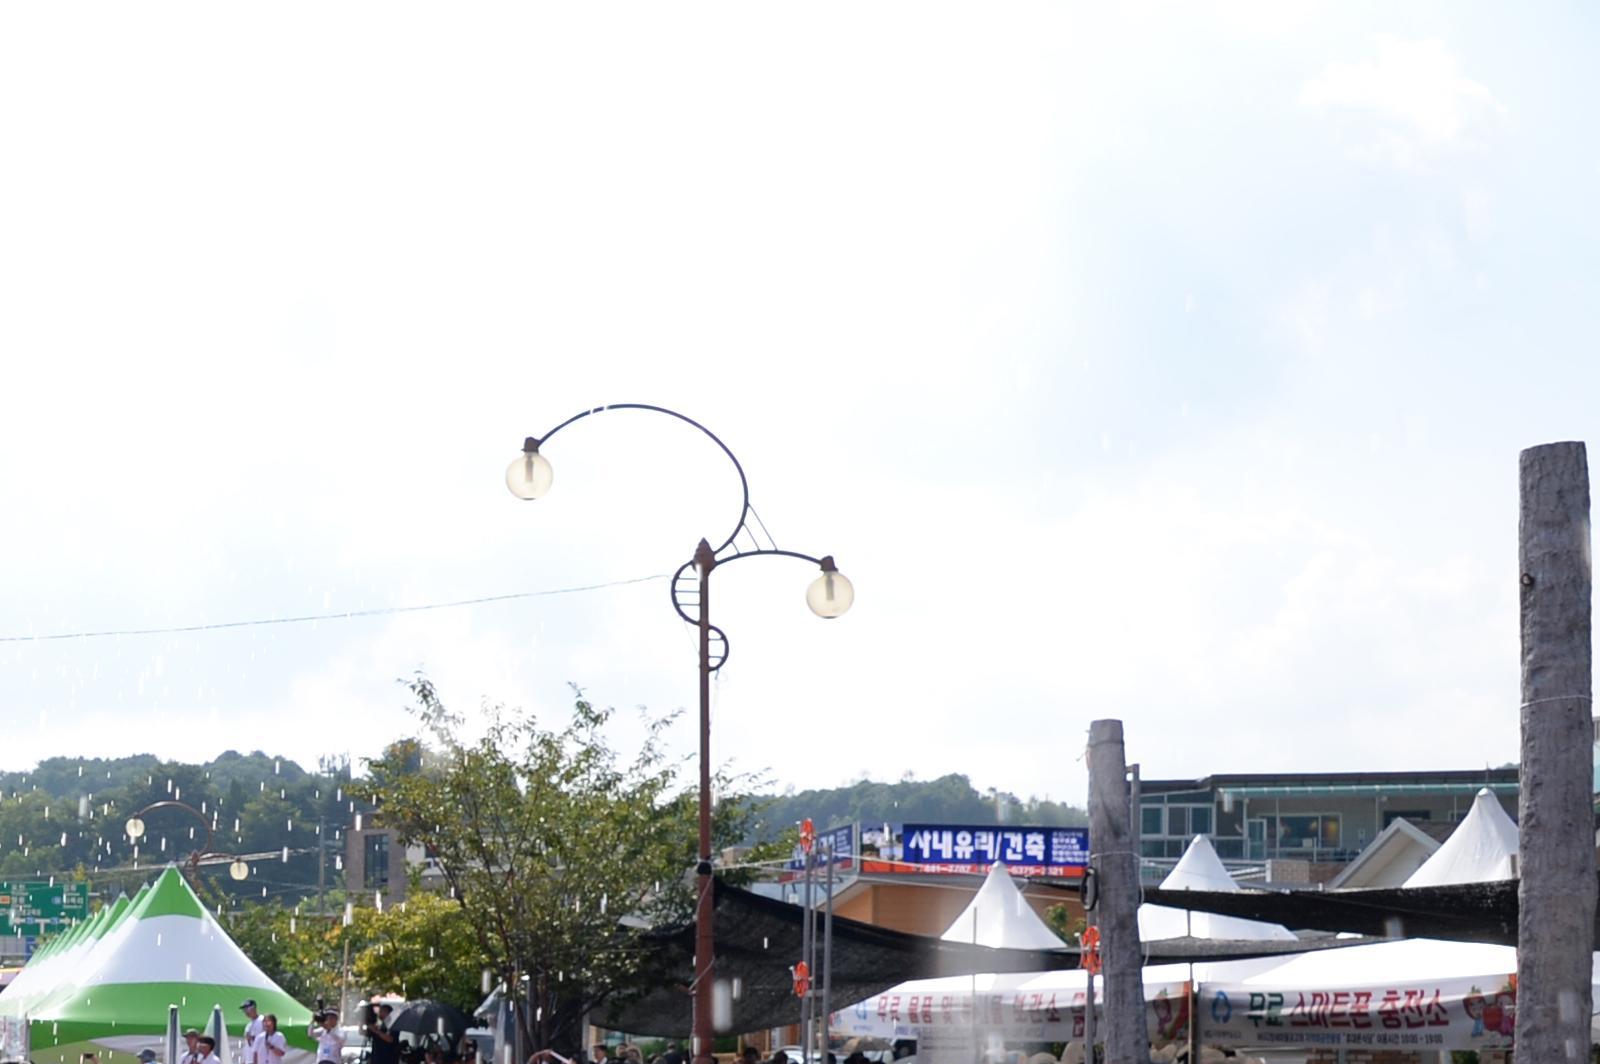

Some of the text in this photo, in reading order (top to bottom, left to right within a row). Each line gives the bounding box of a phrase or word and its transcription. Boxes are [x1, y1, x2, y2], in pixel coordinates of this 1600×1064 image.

[908, 830, 1045, 862] 사내유리/건축
[1249, 988, 1449, 1028] 무료 스마트폰 충전소
